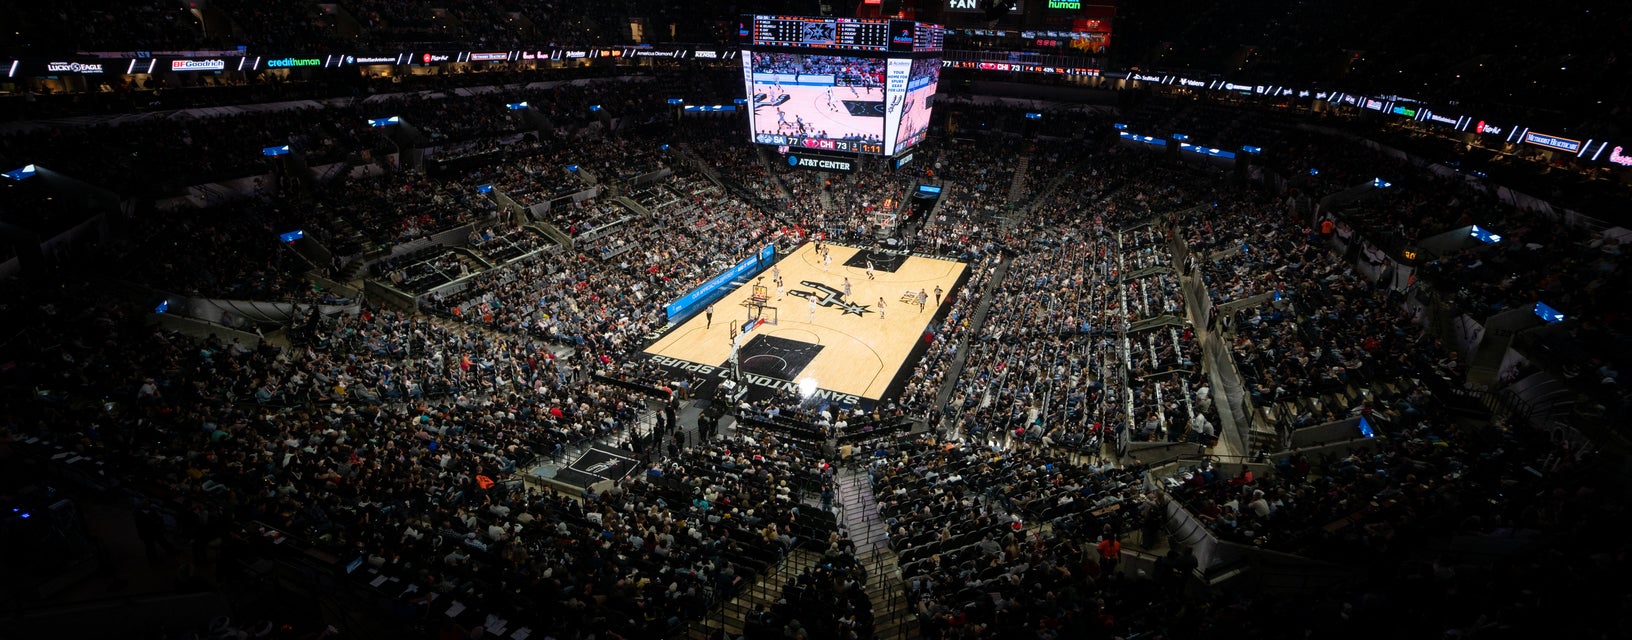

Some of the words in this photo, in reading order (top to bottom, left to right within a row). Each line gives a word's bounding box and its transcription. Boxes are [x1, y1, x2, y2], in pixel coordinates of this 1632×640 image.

[1048, 1, 1081, 9] human
[173, 59, 224, 68] BFGoodrich
[267, 58, 321, 68] credithuman
[997, 63, 1010, 71] CHI
[1011, 64, 1021, 72] 73
[773, 136, 784, 144] SA
[788, 137, 798, 145] 77
[820, 141, 834, 149] CHI
[836, 142, 847, 150] 73
[862, 144, 881, 153] 1:11
[798, 159, 819, 168] AT&T
[819, 160, 850, 170] CENTER
[647, 353, 715, 375] SPURS
[815, 388, 860, 405] SAN
